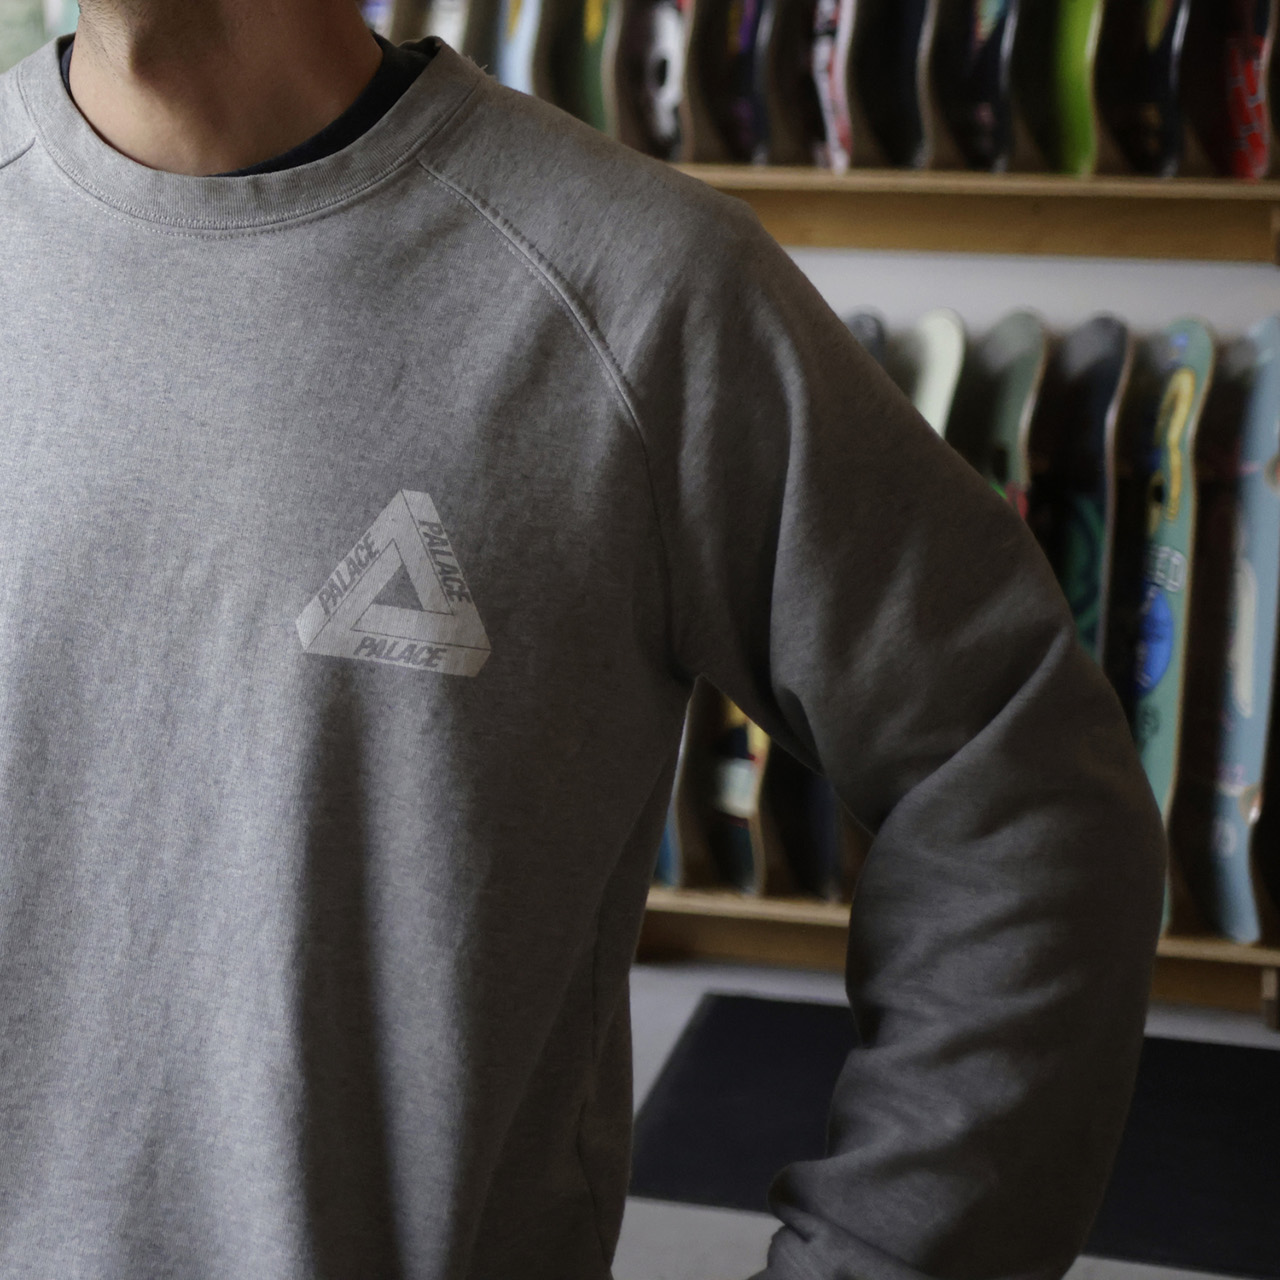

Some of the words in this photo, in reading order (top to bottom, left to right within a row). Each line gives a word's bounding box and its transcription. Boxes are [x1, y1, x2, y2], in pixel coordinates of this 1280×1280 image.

[317, 532, 380, 617] PALACE
[417, 519, 473, 604] PALACE
[352, 635, 448, 668] PALACE
